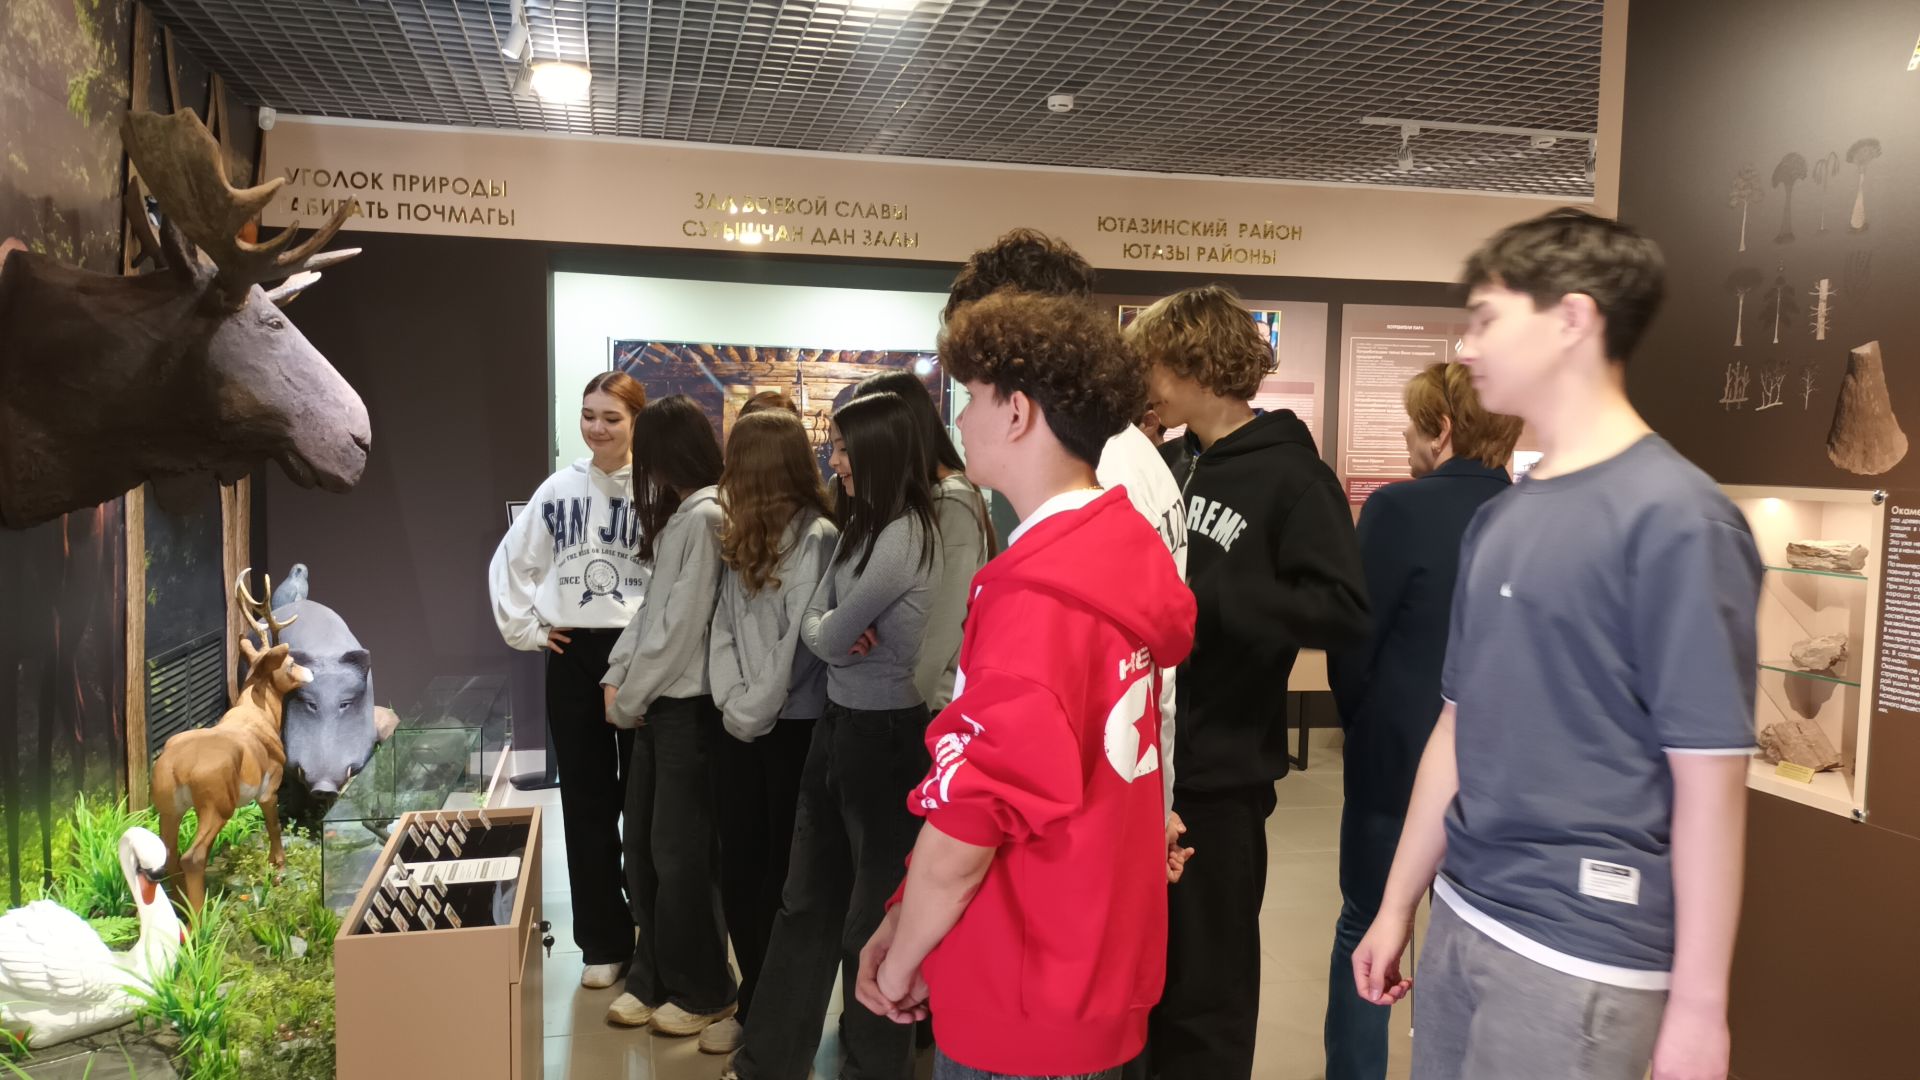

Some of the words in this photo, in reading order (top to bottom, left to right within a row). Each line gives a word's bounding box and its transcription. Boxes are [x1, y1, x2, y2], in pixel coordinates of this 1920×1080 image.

[284, 167, 384, 191] УГОЛОК
[392, 173, 507, 198] ПРИРОДЫ
[397, 202, 515, 226] ПОЧМАГЫ
[694, 192, 737, 214] ЗАЛ
[742, 195, 828, 217] БОЕВОЙ
[835, 200, 908, 220] СЛАВЫ
[811, 227, 855, 246] ДАН
[863, 229, 919, 248] ЗАЛЫ
[1097, 216, 1228, 238] ЮТАЗИНСКИЙ
[1238, 220, 1303, 241] РАЙОН
[1123, 242, 1190, 262] ЮТАЗЫ
[1197, 243, 1276, 265] РАЙОНЫ
[624, 577, 643, 586] 1995
